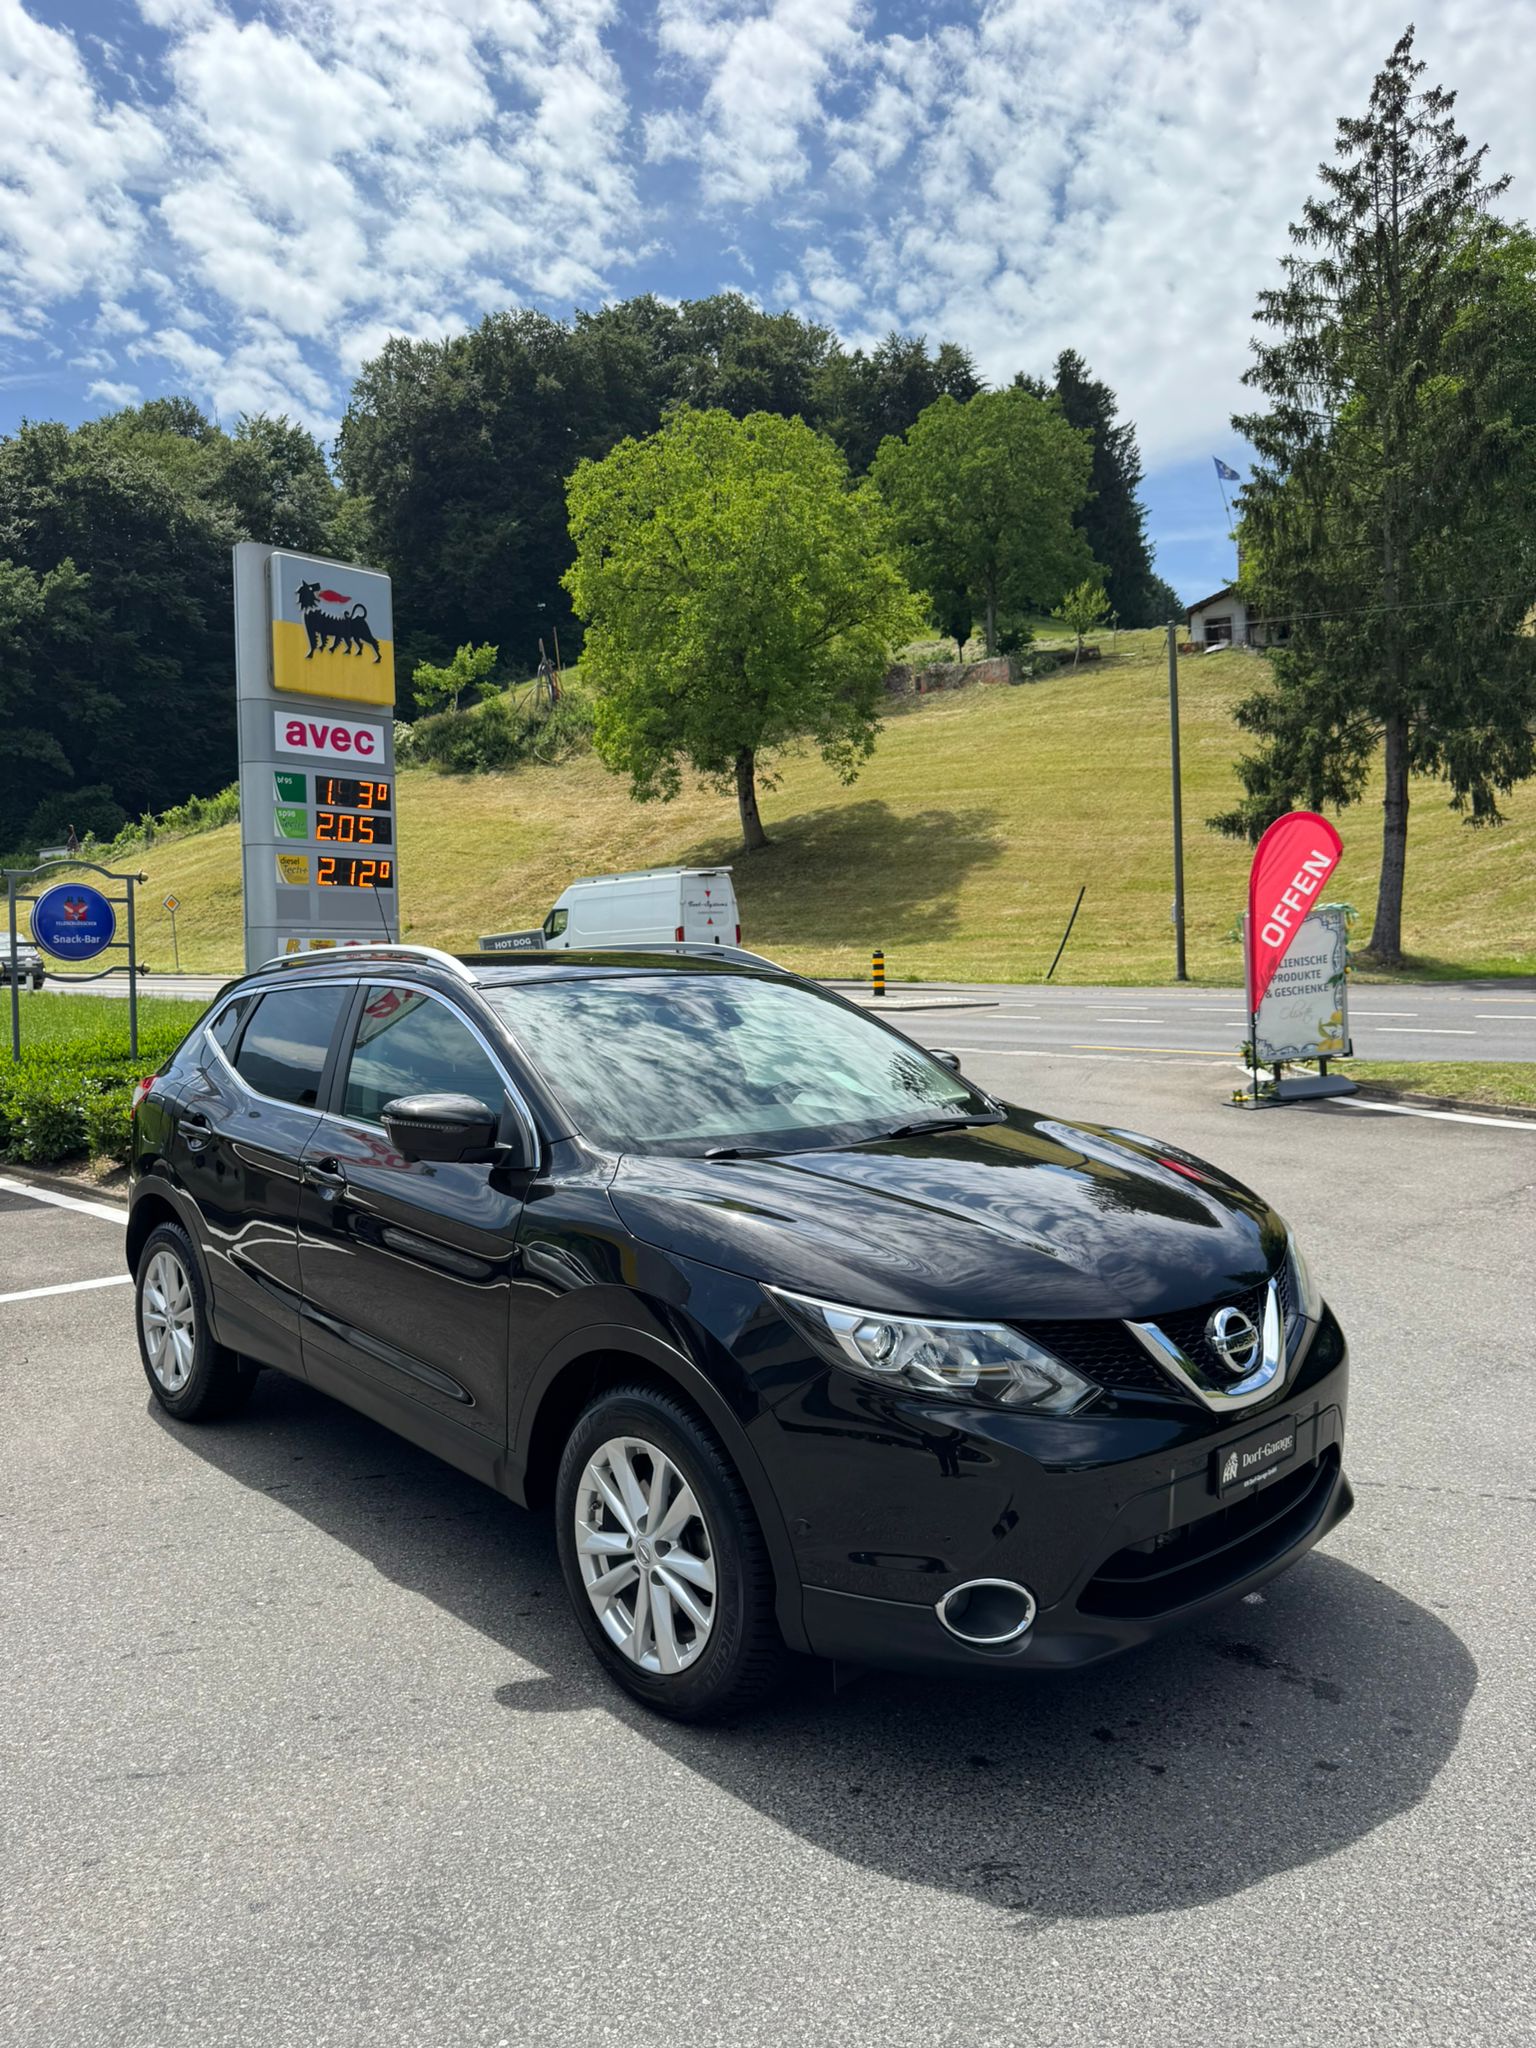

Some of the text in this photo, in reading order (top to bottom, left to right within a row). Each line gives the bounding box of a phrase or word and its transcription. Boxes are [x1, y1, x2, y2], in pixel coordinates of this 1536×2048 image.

[286, 720, 375, 756] avec
[1261, 849, 1332, 948] OFFEN
[53, 934, 101, 944] Snack-Bar
[494, 940, 512, 949] HOT
[513, 937, 531, 947] DOG
[1279, 954, 1328, 969] LIENISCHE
[1271, 969, 1322, 984] PRODUKTE
[1274, 983, 1329, 998] GESCHENKE
[1242, 1434, 1293, 1468] Dorf-Garage
